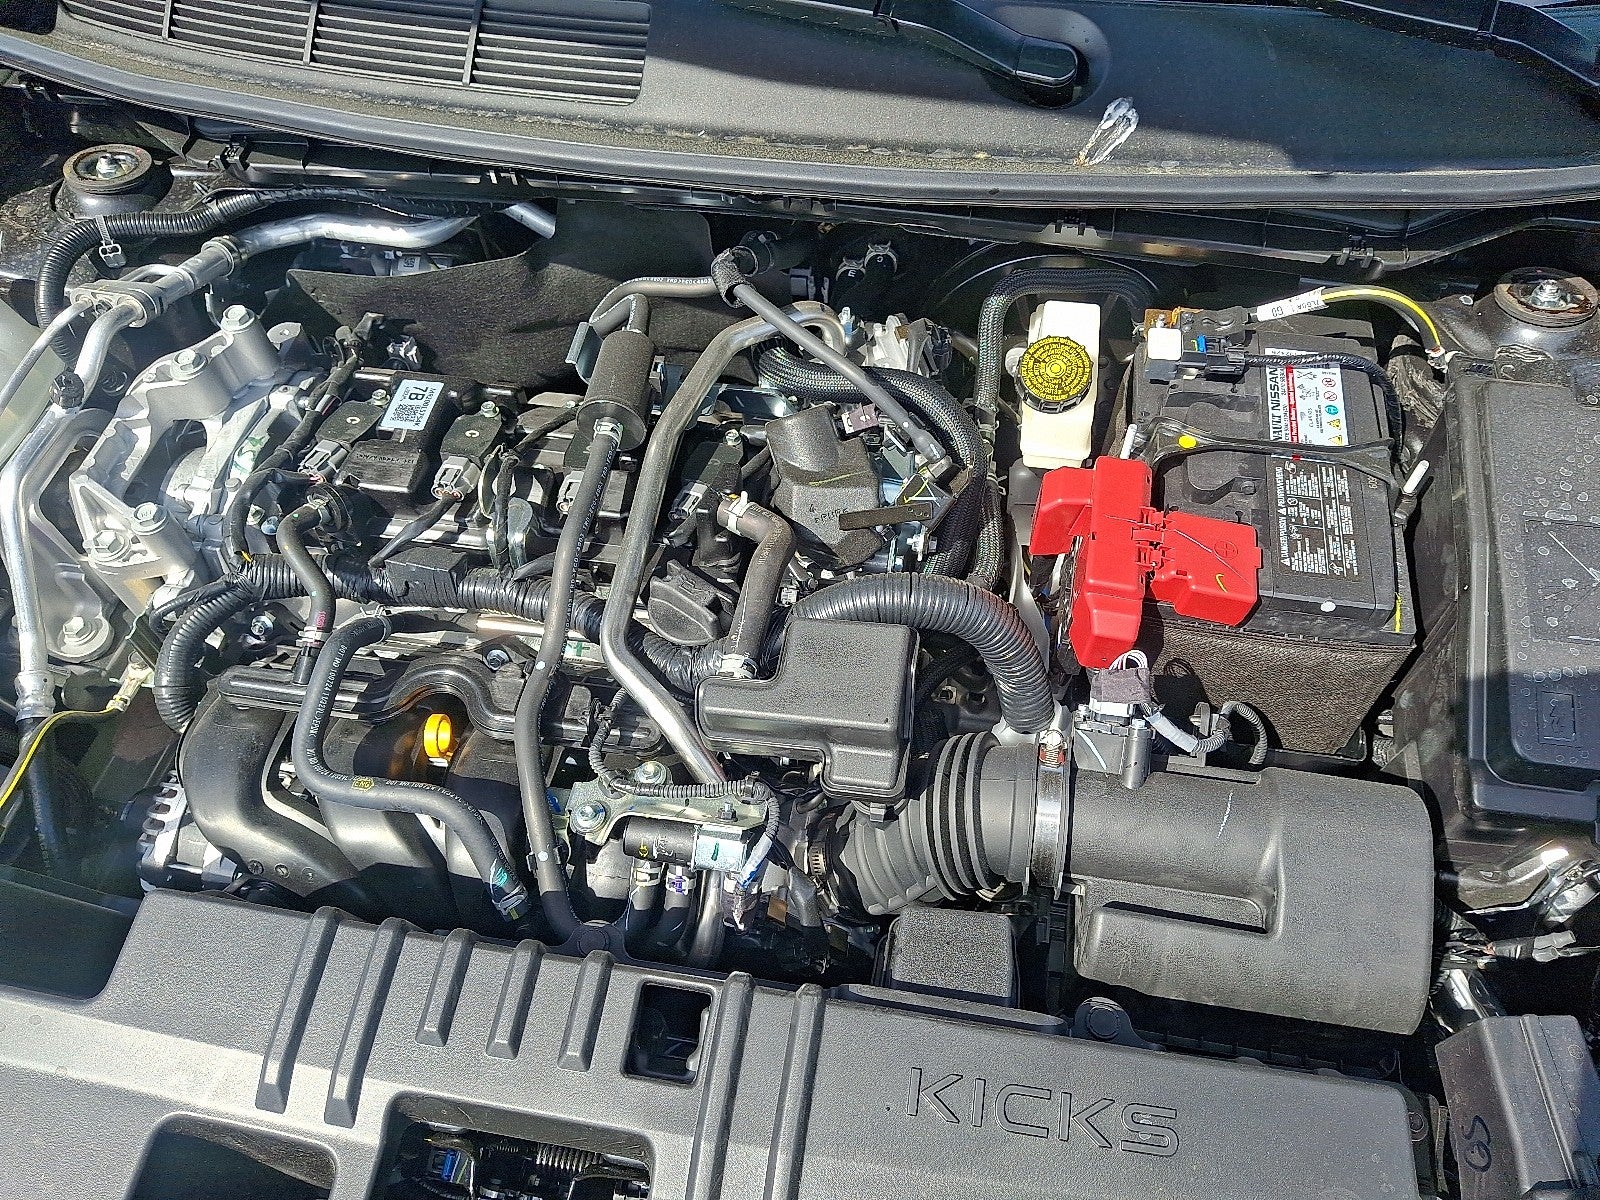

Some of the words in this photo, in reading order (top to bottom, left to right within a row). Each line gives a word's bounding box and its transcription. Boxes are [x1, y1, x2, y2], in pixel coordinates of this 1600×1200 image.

[408, 386, 429, 400] 7B
[1269, 367, 1280, 410] NISSAN
[906, 1067, 1179, 1157] KICKS
